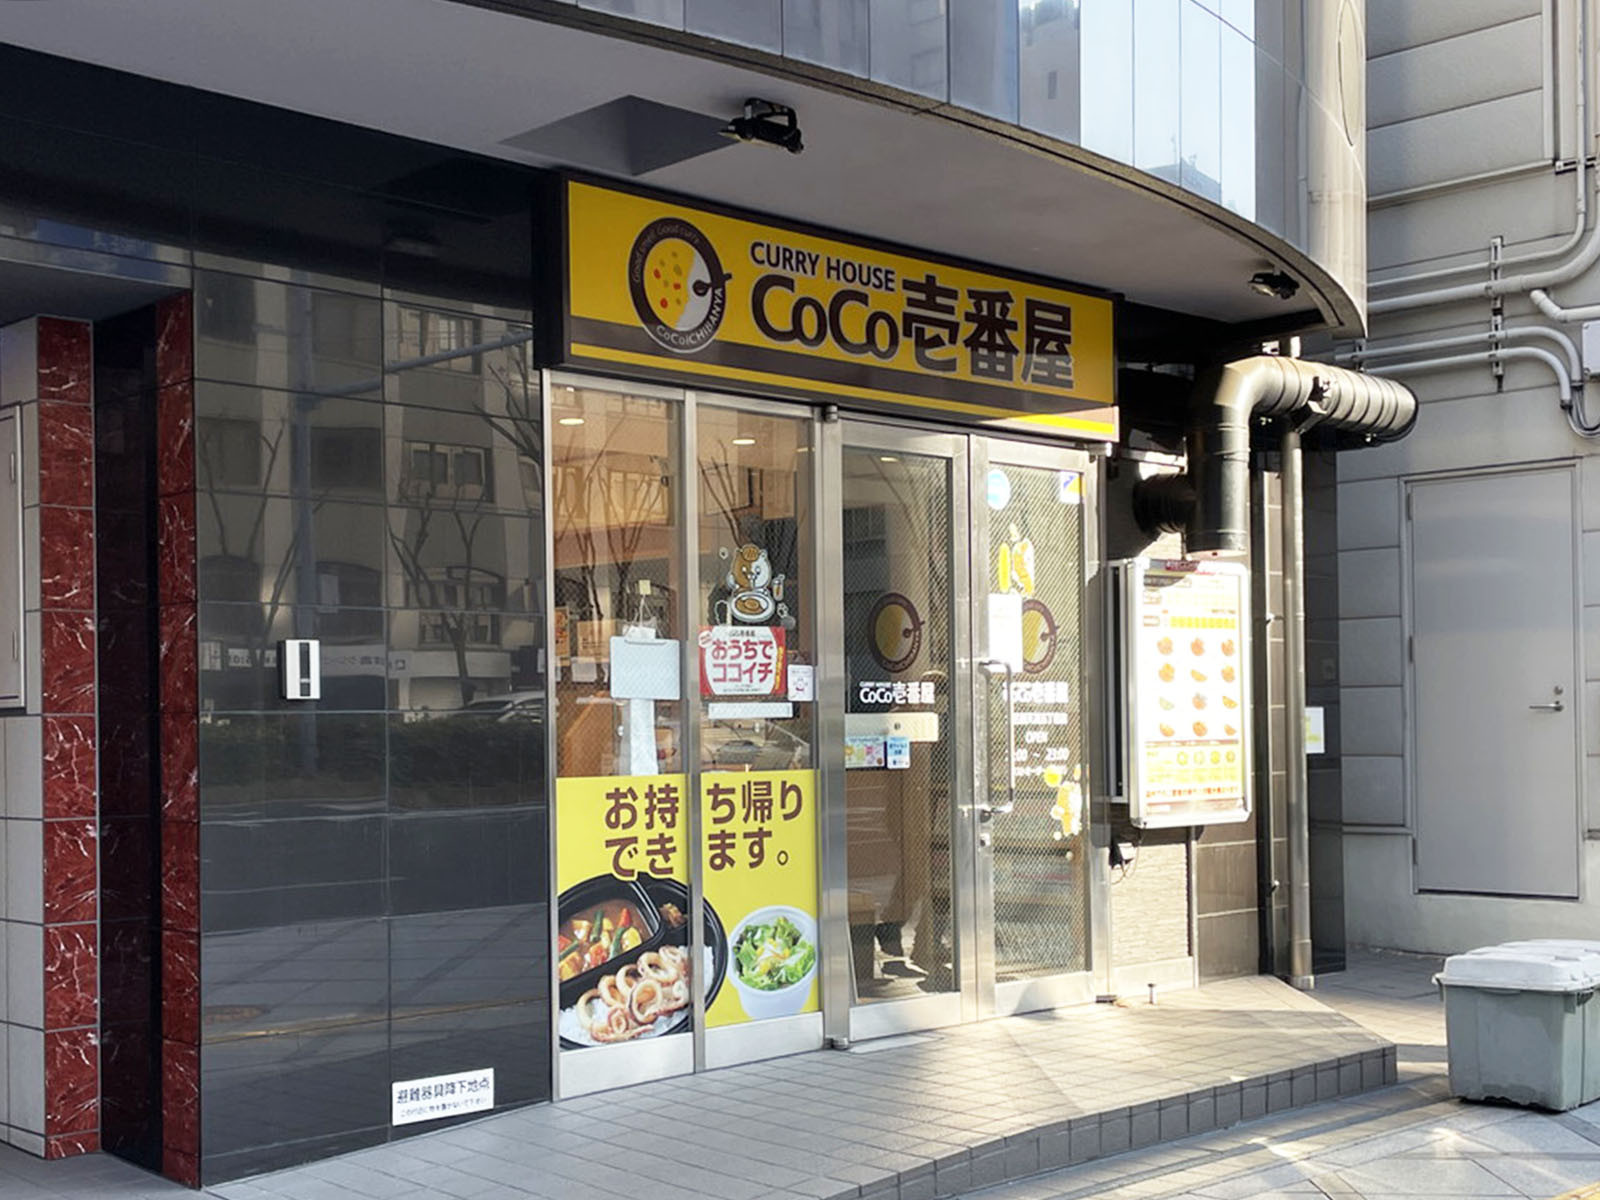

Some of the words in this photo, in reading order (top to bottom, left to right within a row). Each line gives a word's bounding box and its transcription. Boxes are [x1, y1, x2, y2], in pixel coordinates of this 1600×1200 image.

[750, 242, 820, 277] CURRY
[826, 257, 896, 292] HOUSE
[750, 273, 1075, 390] CoCo壱番屋
[711, 639, 774, 660] おうちで
[712, 662, 773, 684] ココイチ
[397, 1077, 490, 1104] 避難器具降下地点
